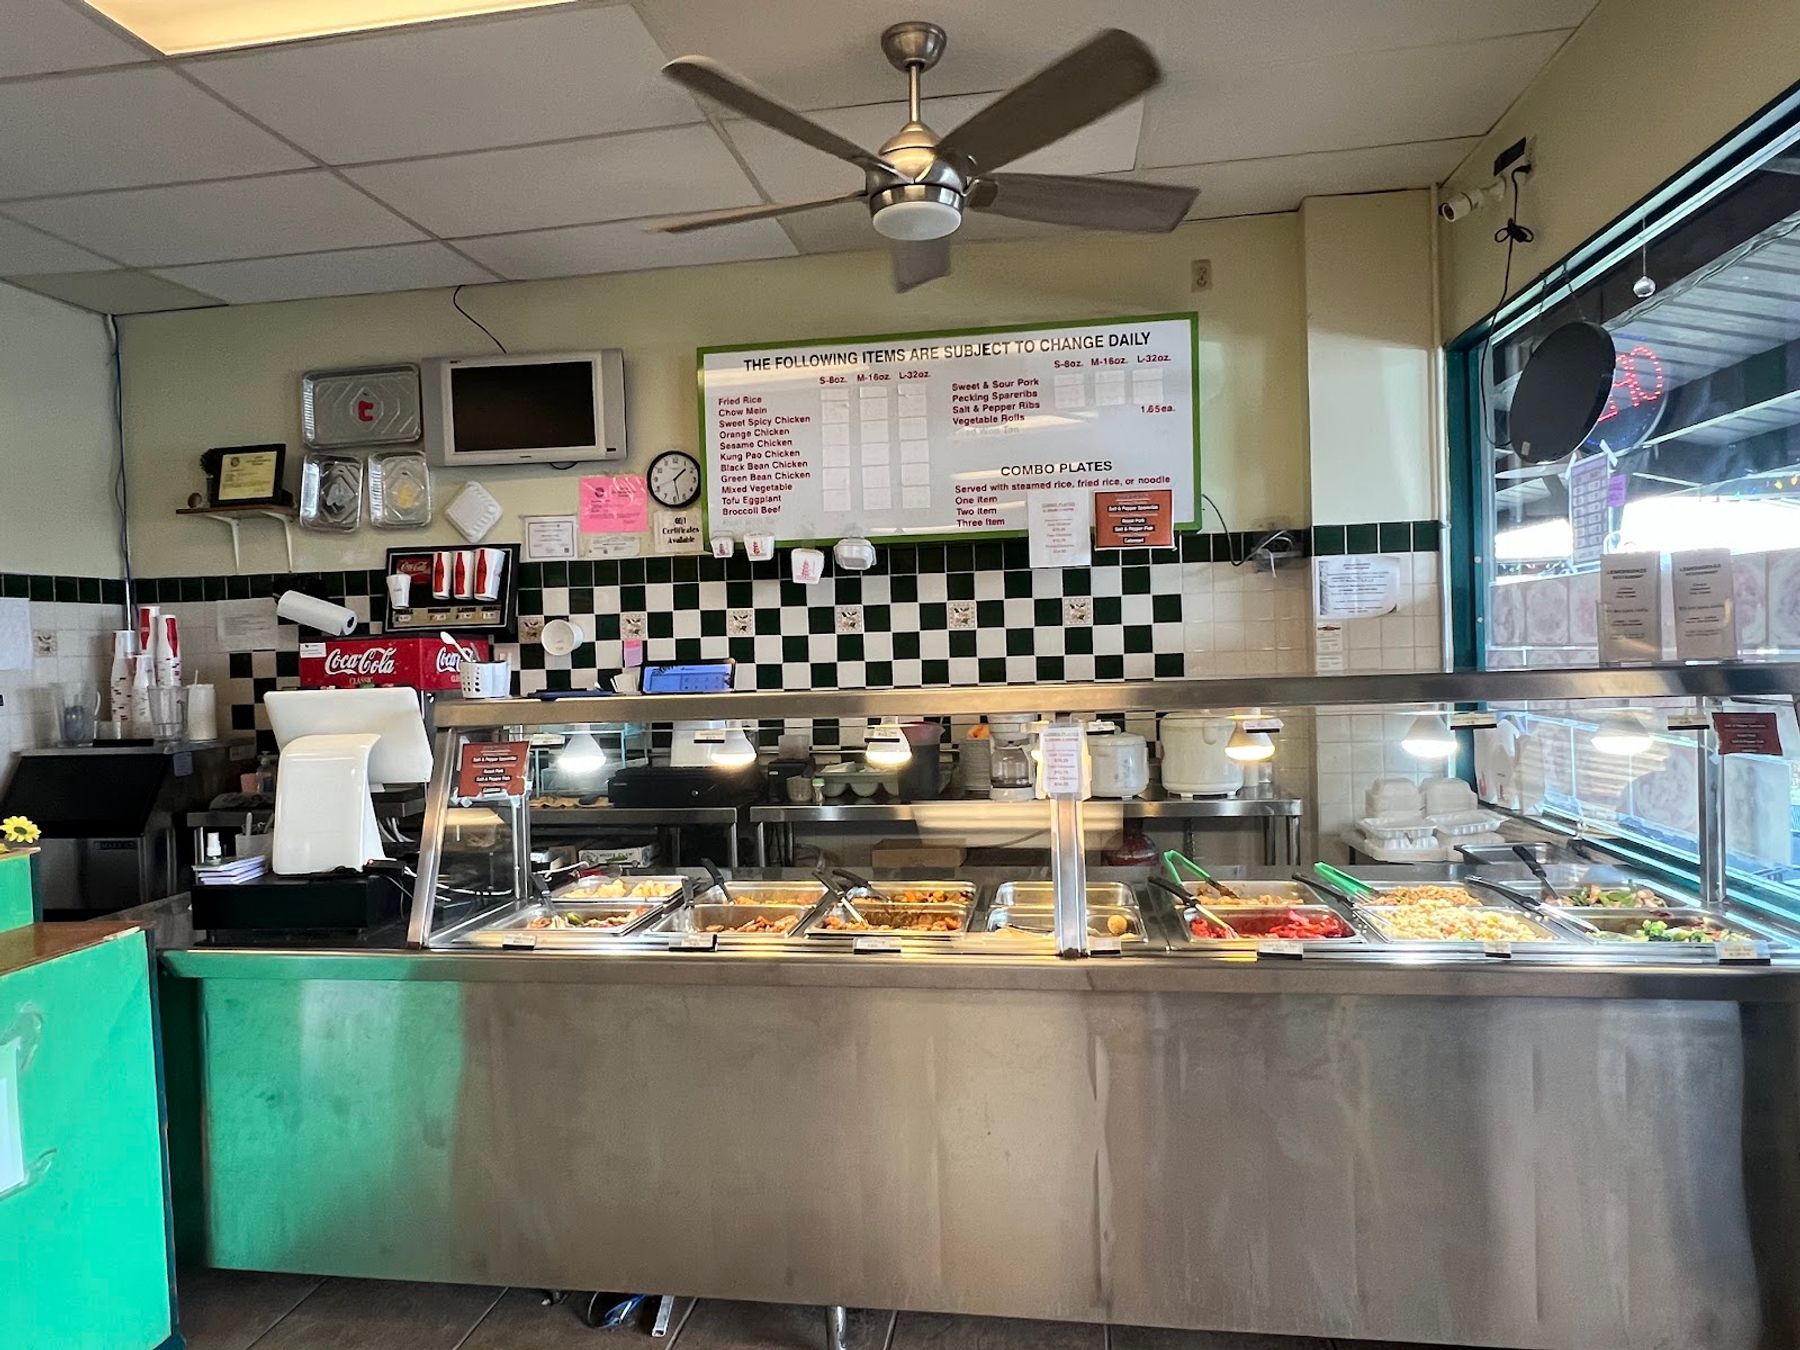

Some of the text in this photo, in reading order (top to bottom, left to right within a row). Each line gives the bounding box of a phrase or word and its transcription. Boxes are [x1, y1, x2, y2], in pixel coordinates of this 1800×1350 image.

[744, 332, 1151, 372] THE FOLLOWING ITEMS ARE SUBJECT TO CHANGE DAILY
[1137, 354, 1172, 363] L-32oz.
[952, 377, 1040, 392] Sweet & Sour Pork
[718, 396, 762, 406] Fried Rice
[952, 389, 1038, 404] Pecking Spareribs
[718, 407, 767, 417] Chow Mein
[952, 400, 1040, 415] Salt & Pepper Ribs
[719, 415, 811, 429] Sweet Spicy Chicken
[952, 413, 1025, 427] Vegetable Rolls
[719, 427, 790, 440] Orange Chicken
[720, 439, 793, 450] Sesame Chicken
[720, 449, 800, 462] Kung Pao Chicken
[720, 460, 808, 472] Black Bean Chicken
[1001, 460, 1113, 477] COMBO PLATES
[721, 470, 811, 484] Green Bean Chicken
[721, 482, 793, 494] Mixed Vegetable
[955, 484, 987, 494] Served
[989, 483, 1009, 492] with
[1011, 480, 1051, 491] steamed
[1077, 477, 1099, 487] fried
[1125, 476, 1136, 486] or
[1138, 474, 1171, 485] noodle
[722, 494, 782, 506] Tofu Eggplant
[955, 496, 974, 505] One
[722, 505, 782, 516] Broccoli Beef
[956, 507, 974, 516] Two
[957, 518, 983, 528] Three
[325, 647, 397, 675] Coca-Cola
